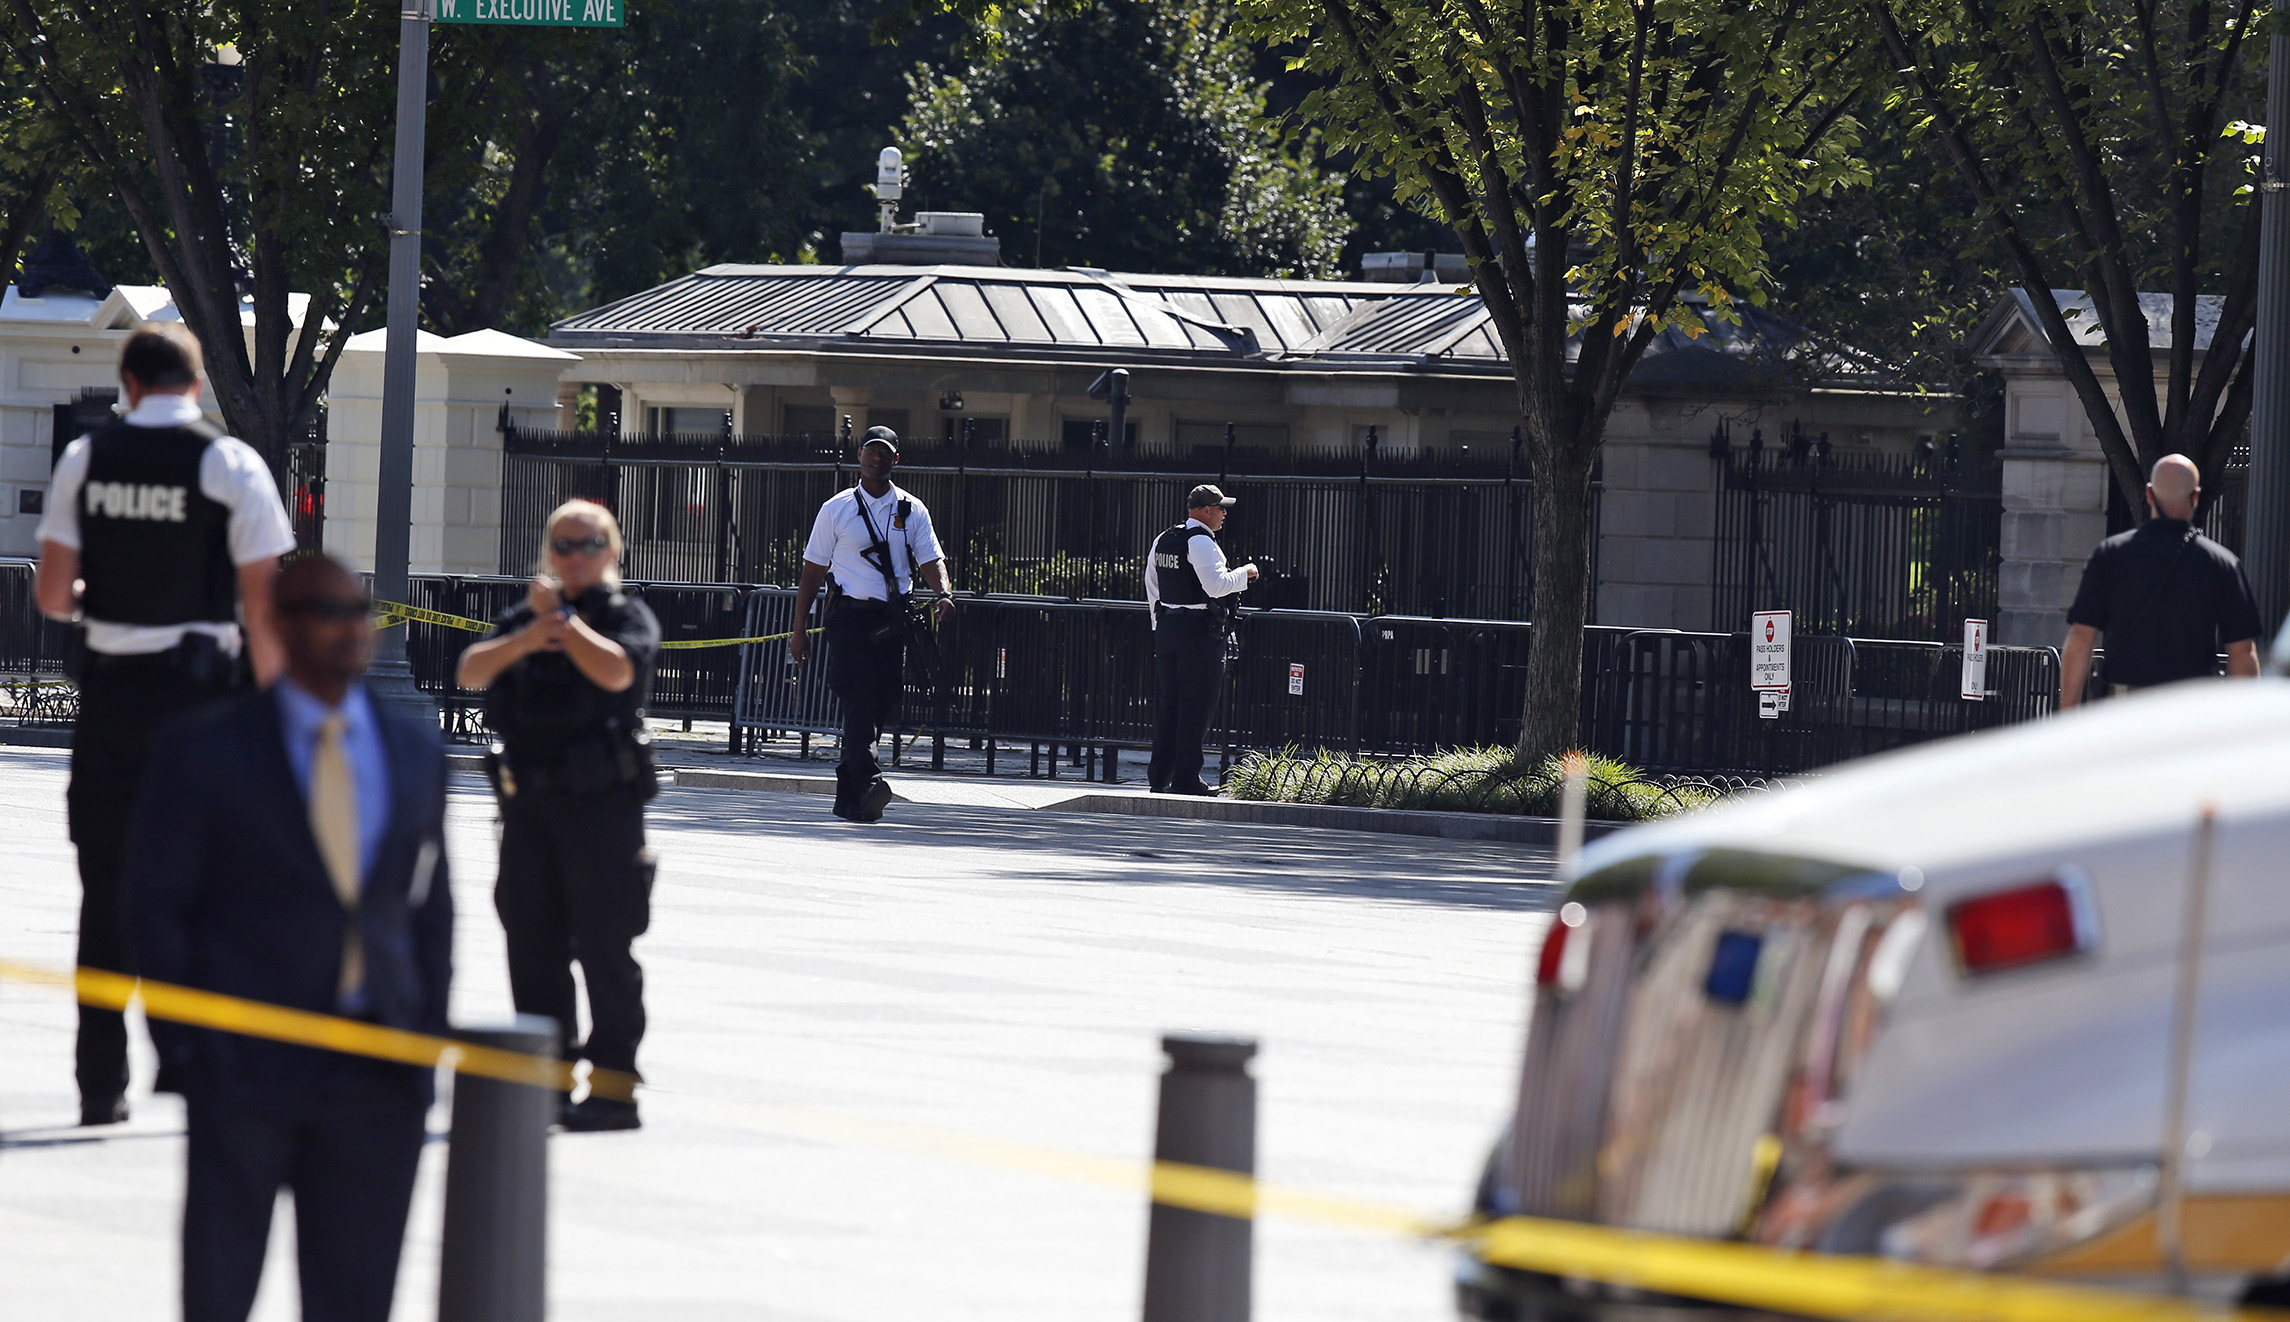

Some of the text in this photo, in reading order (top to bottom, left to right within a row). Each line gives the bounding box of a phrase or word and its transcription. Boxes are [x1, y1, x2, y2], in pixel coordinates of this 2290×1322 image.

[441, 0, 616, 22] W. EXECUTIVE AVE
[87, 482, 187, 521] POLICE
[1155, 552, 1179, 569] POLICE
[1756, 644, 1785, 653] PASS HOLDERS
[1756, 663, 1785, 671] APPOINTMENTS
